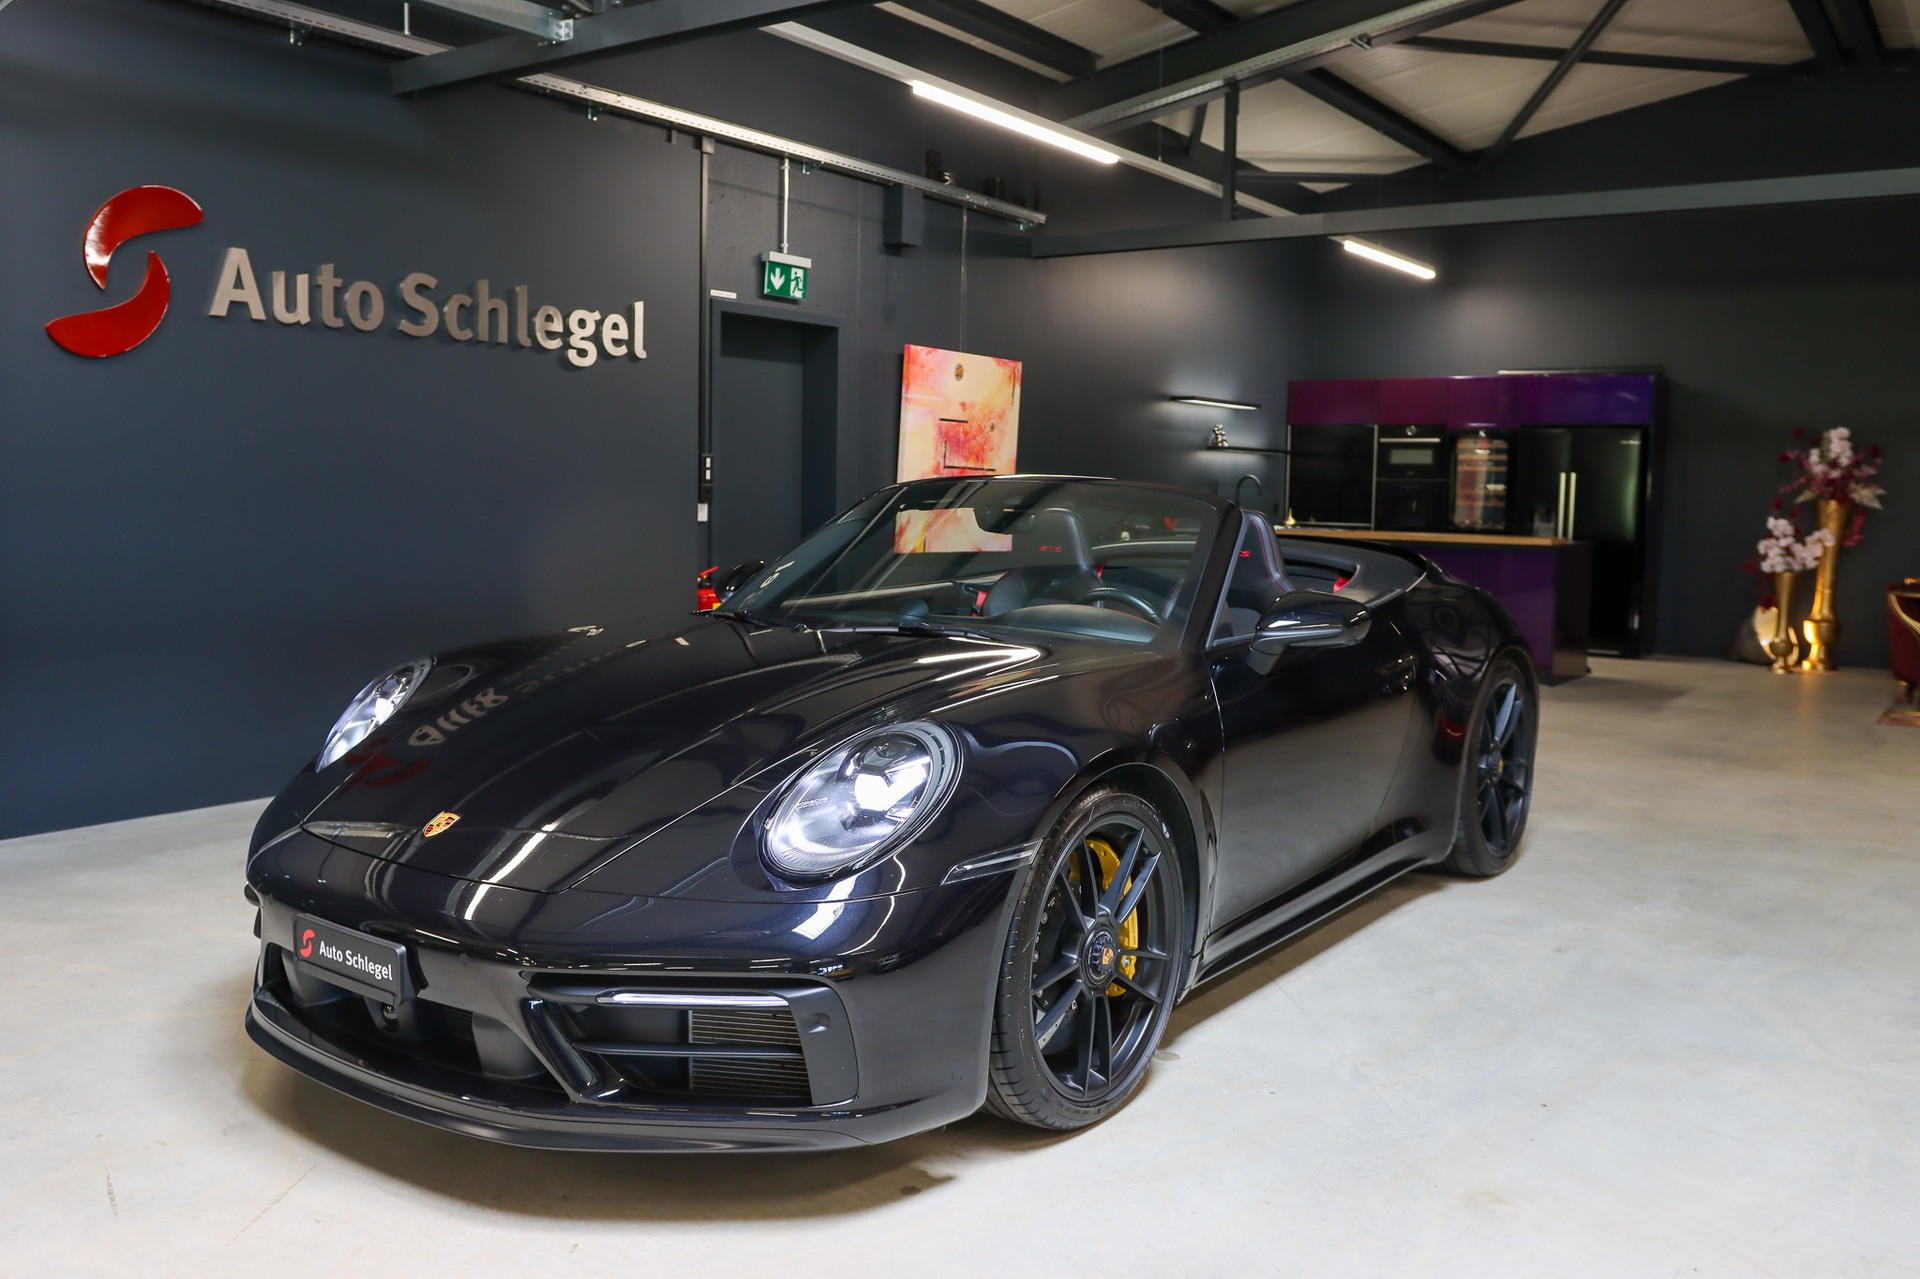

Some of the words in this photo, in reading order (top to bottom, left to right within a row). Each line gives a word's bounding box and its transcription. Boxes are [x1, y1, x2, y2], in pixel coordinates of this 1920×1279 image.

[208, 247, 385, 331] Auto
[399, 272, 648, 368] Schlegel
[319, 940, 343, 962] Auto
[345, 949, 393, 980] Schlegel
